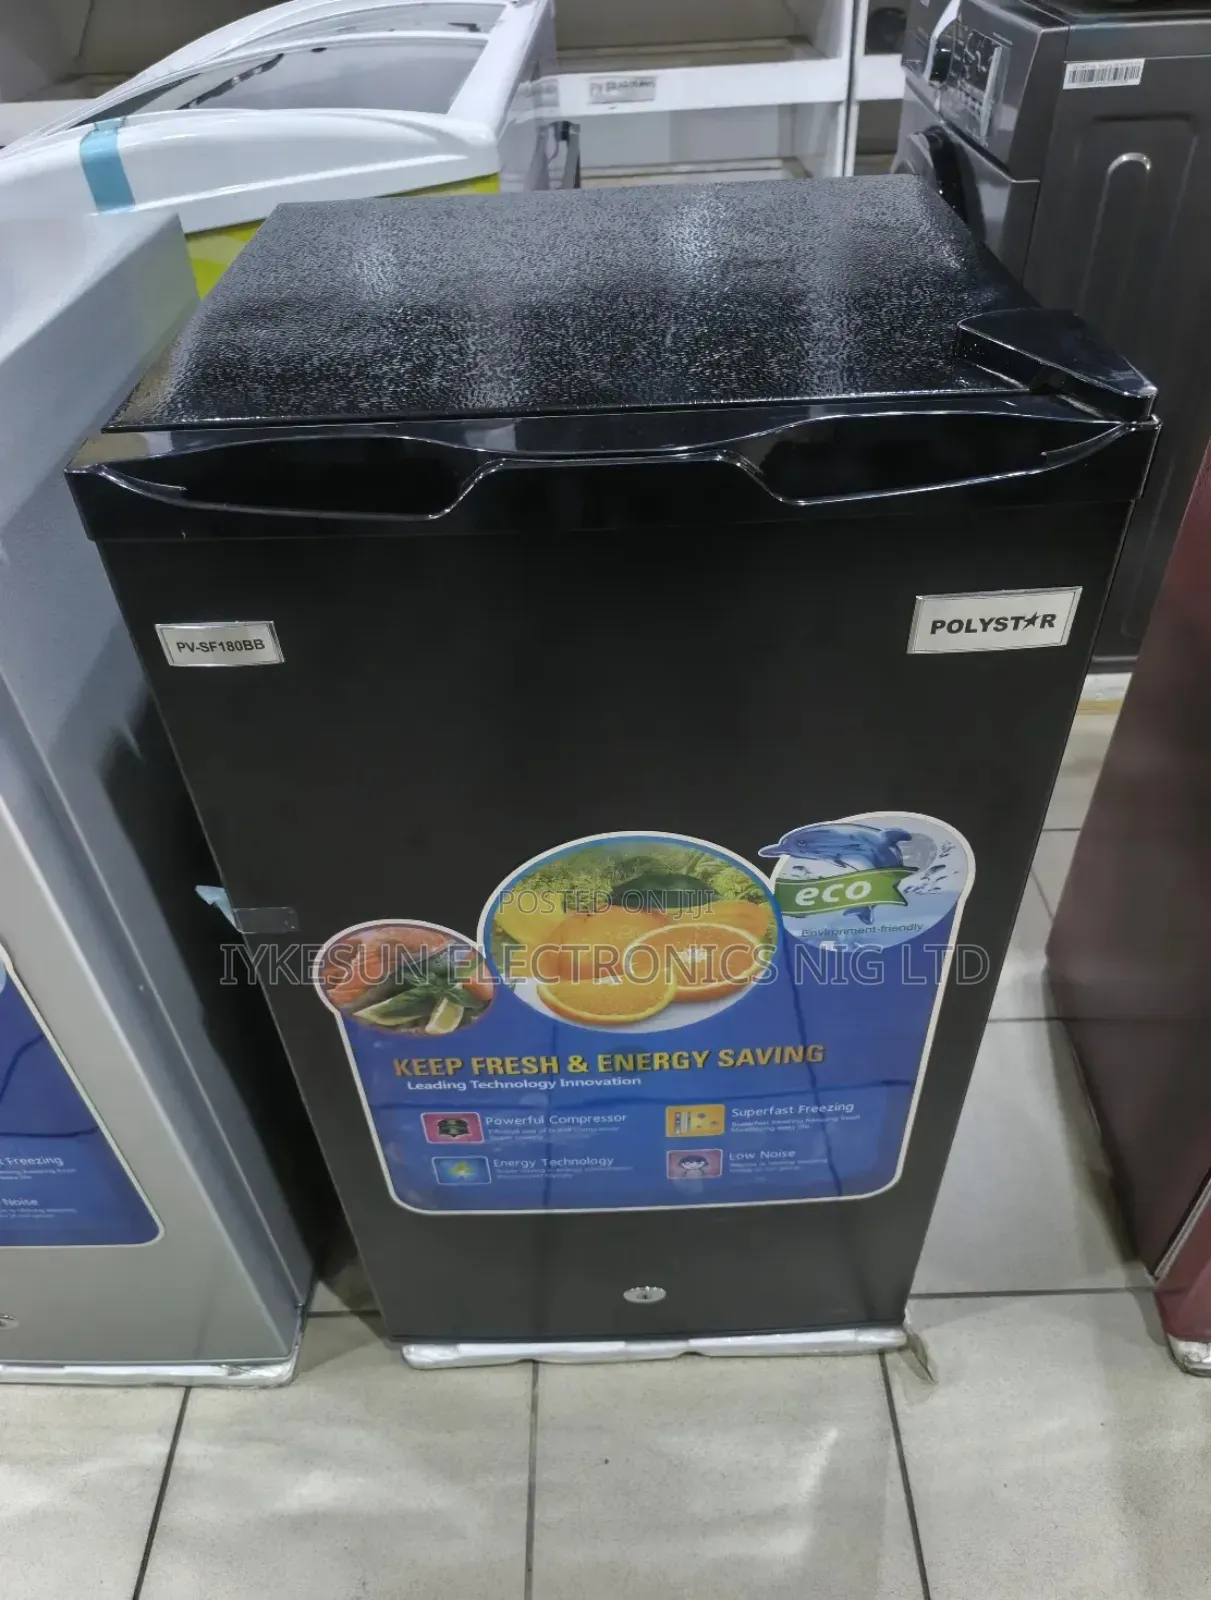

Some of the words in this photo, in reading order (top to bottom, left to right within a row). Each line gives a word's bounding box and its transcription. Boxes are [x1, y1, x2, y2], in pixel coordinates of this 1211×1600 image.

[176, 639, 265, 653] PV-SF180BB
[795, 880, 872, 906] eco
[801, 923, 924, 938] Environment-friendly
[393, 1057, 464, 1077] KEEP
[471, 1056, 560, 1076] FRESH
[597, 1050, 710, 1073] ENERGY
[717, 1044, 825, 1068] SAVING
[407, 1081, 467, 1092] Leading
[470, 1079, 557, 1090] Technology
[560, 1076, 642, 1088] Innovation
[731, 1105, 795, 1119] Superfast
[798, 1102, 855, 1114] Freezing
[485, 1115, 545, 1126] Powerful
[549, 1114, 627, 1125] Compressor
[493, 1159, 536, 1169] Energy
[540, 1156, 615, 1167] Technology
[729, 1153, 756, 1161] Low
[760, 1150, 796, 1160] Noise
